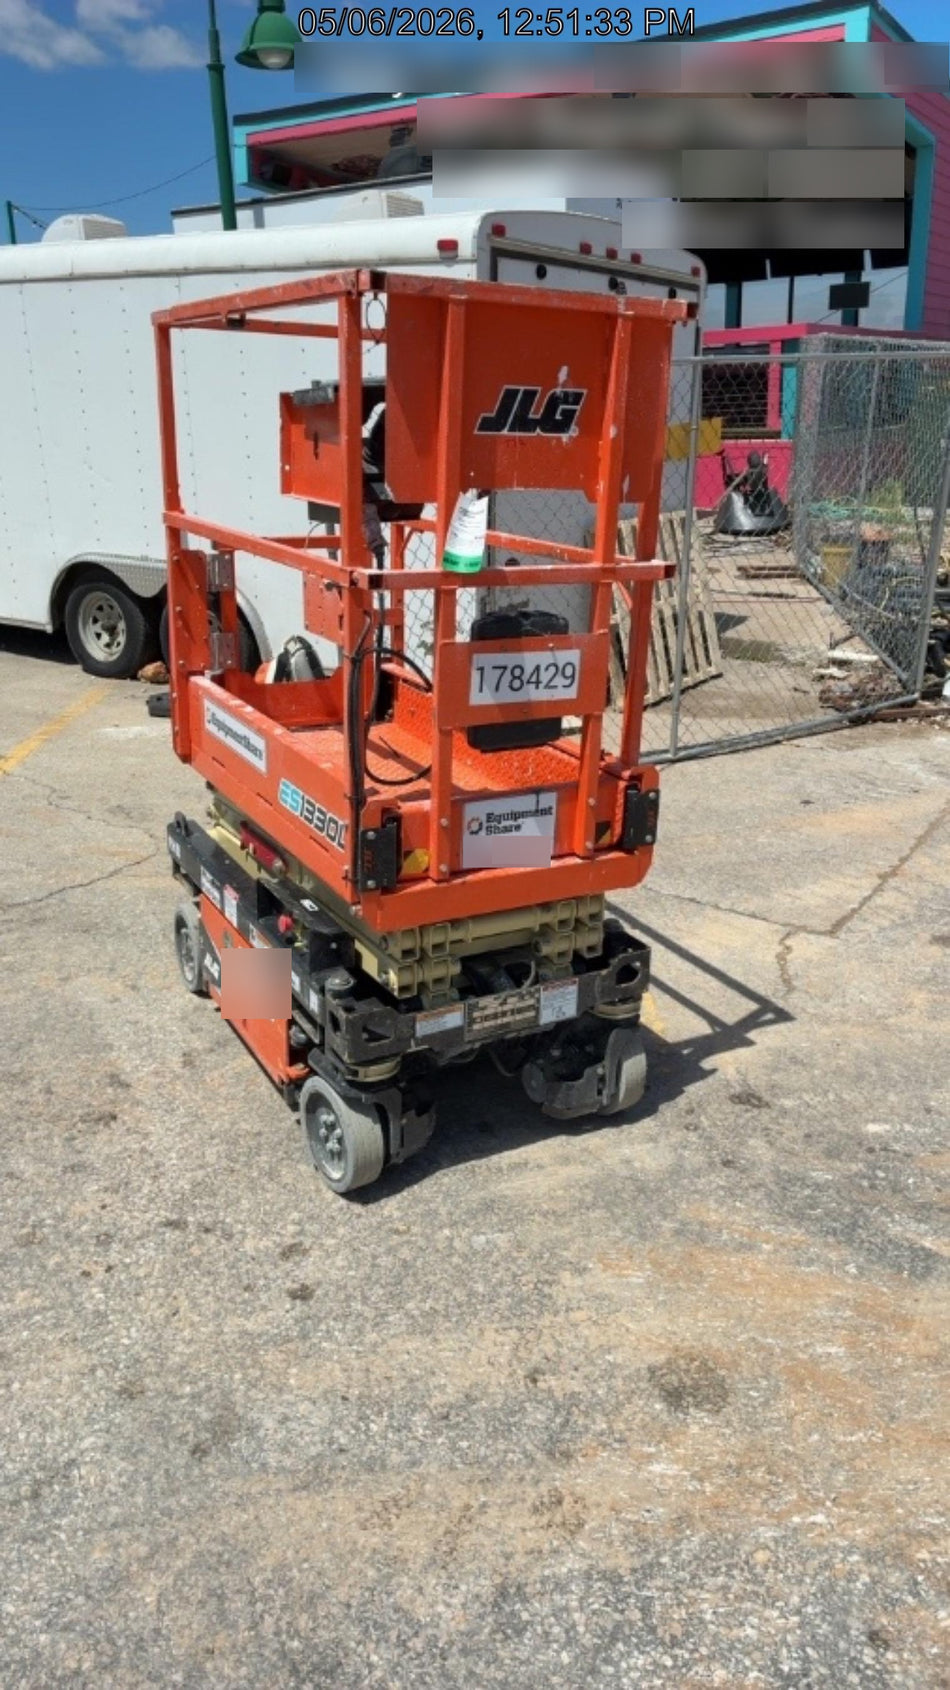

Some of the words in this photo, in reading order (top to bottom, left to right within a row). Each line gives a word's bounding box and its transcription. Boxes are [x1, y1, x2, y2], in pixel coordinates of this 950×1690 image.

[475, 385, 587, 436] JLG
[475, 662, 576, 693] 178429
[486, 823, 522, 836] Share
